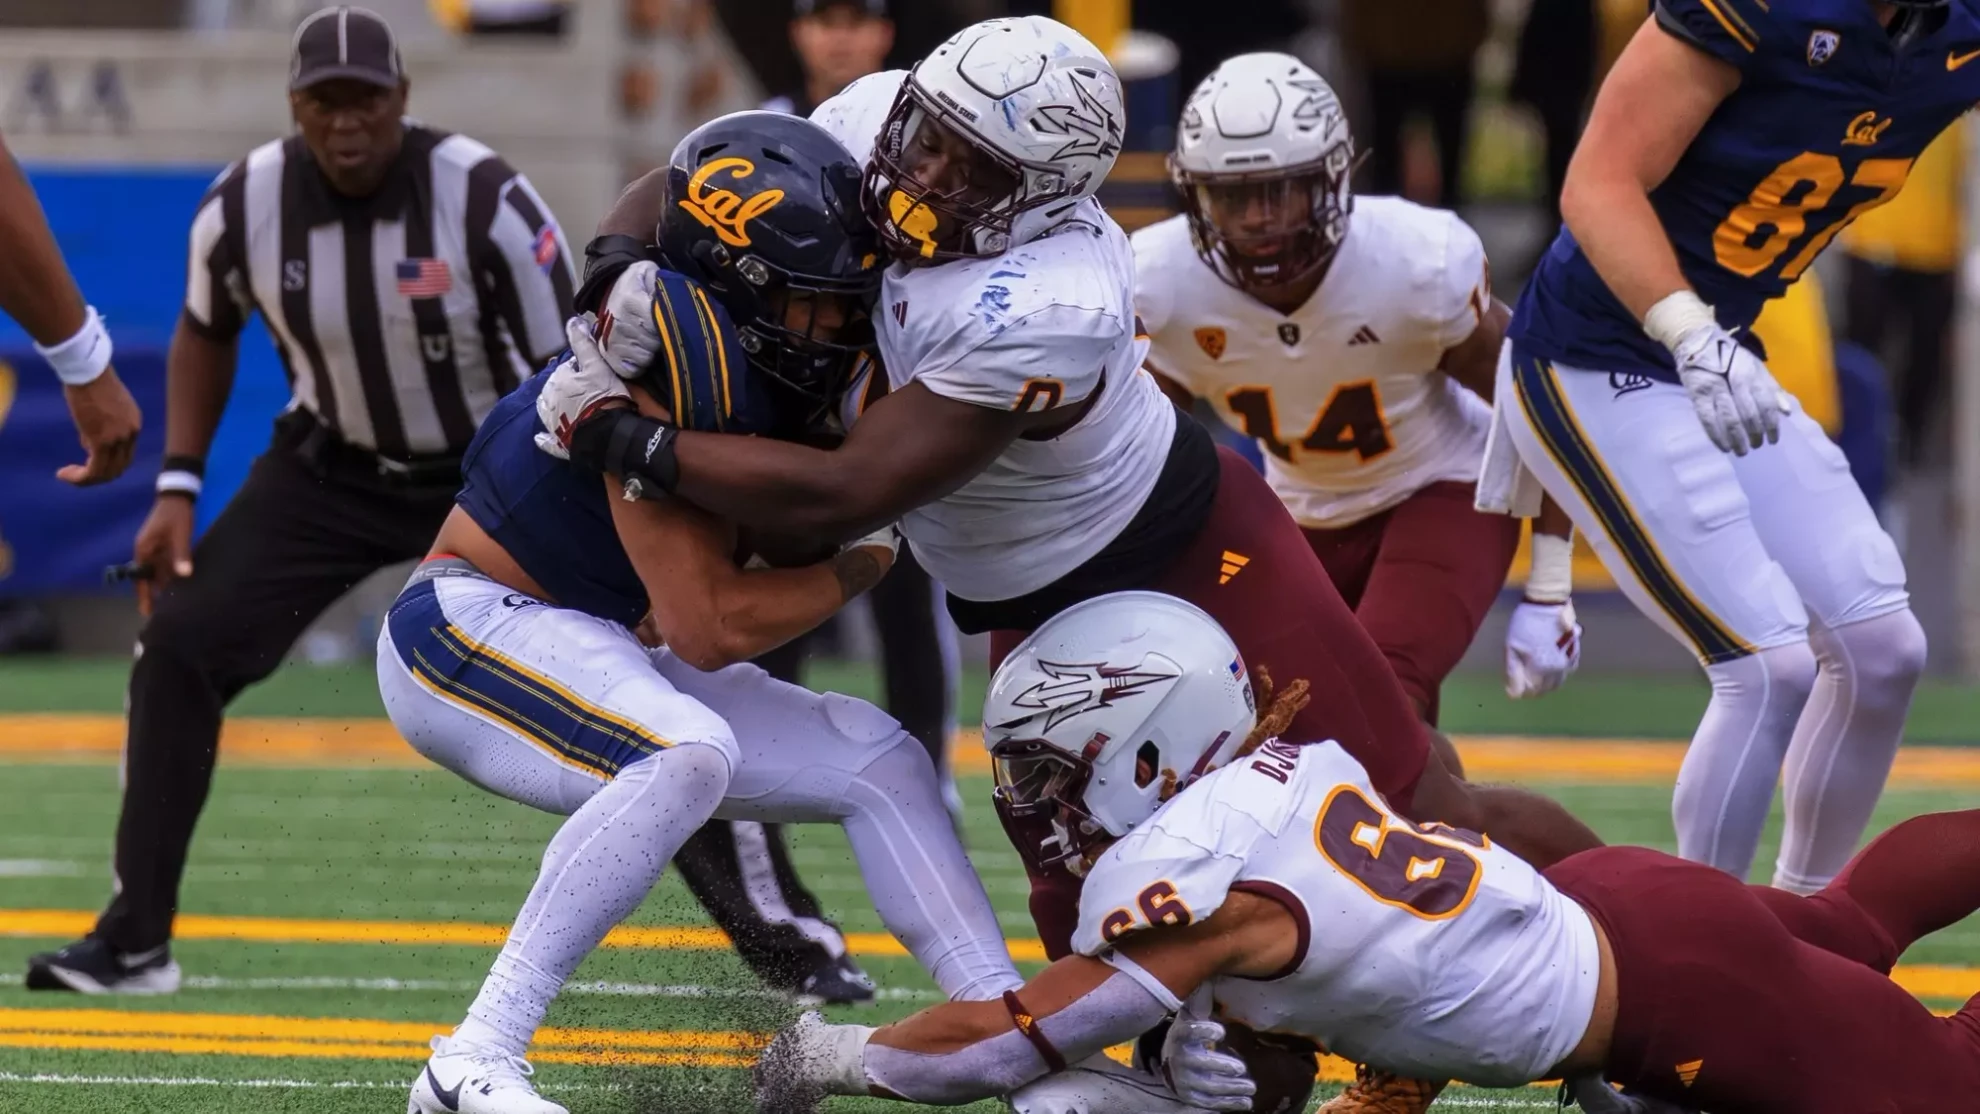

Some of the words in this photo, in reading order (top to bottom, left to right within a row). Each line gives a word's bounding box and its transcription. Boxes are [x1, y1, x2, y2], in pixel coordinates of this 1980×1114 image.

[1840, 111, 1892, 146] Cal
[678, 157, 785, 247] Cal
[1712, 150, 1914, 279] 87
[283, 259, 306, 292] S
[1225, 377, 1396, 466] 14
